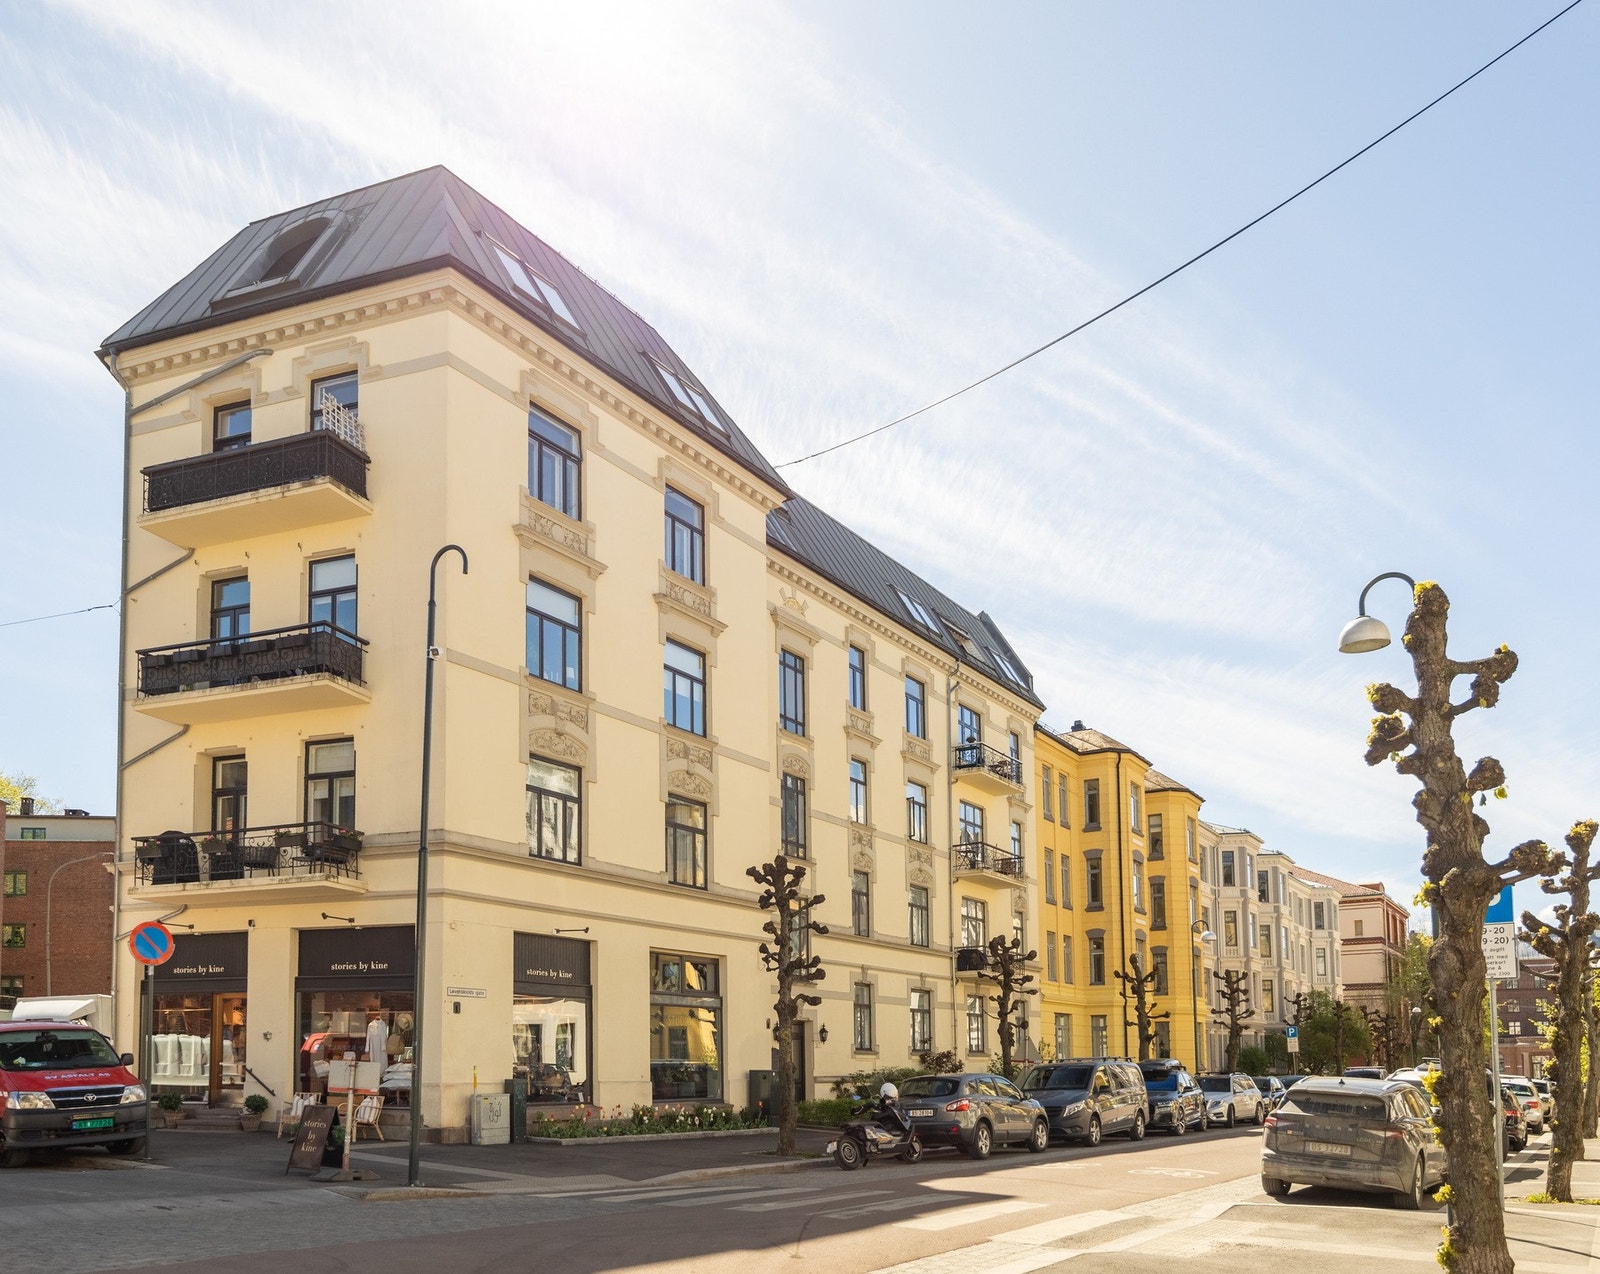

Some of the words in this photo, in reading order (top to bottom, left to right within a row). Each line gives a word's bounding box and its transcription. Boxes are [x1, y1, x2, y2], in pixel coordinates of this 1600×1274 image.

[173, 965, 197, 974] stories
[198, 964, 207, 976] by
[208, 964, 225, 973] kine
[331, 961, 357, 970] stories
[359, 961, 369, 972] by
[371, 960, 389, 970] kine
[526, 967, 549, 977] stories
[549, 968, 558, 980] by
[558, 969, 573, 979] kine
[1289, 1027, 1295, 1036] P
[304, 1118, 327, 1128] stories
[308, 1130, 316, 1142] by
[302, 1142, 317, 1152] kine
